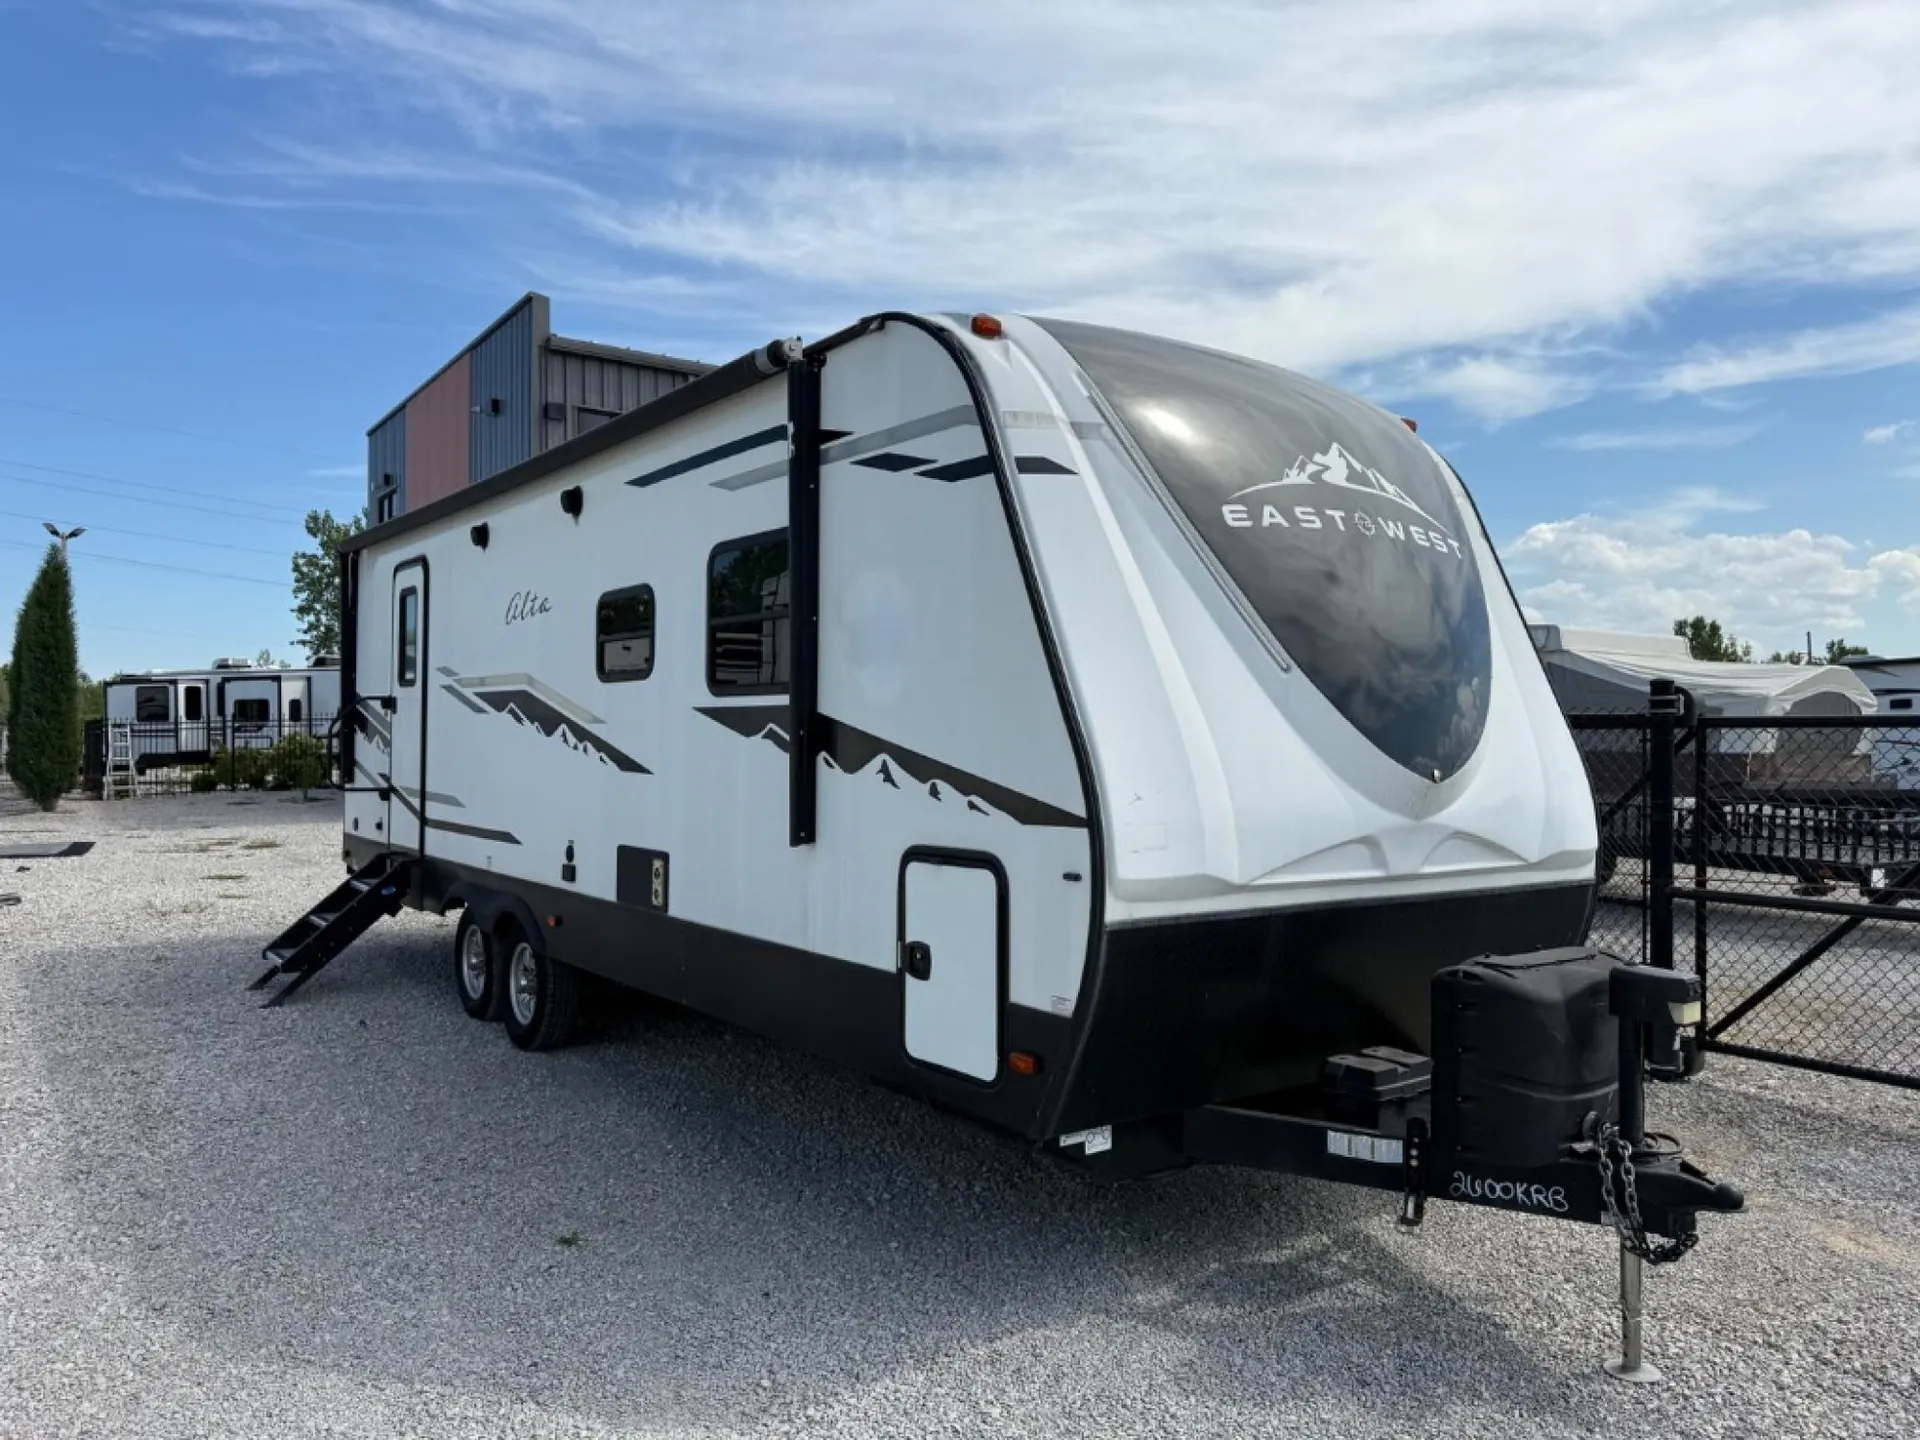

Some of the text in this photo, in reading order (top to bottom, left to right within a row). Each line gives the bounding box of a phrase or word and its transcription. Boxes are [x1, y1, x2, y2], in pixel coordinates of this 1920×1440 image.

[1221, 504, 1463, 559] EAST WEST
[505, 590, 553, 625] Alta
